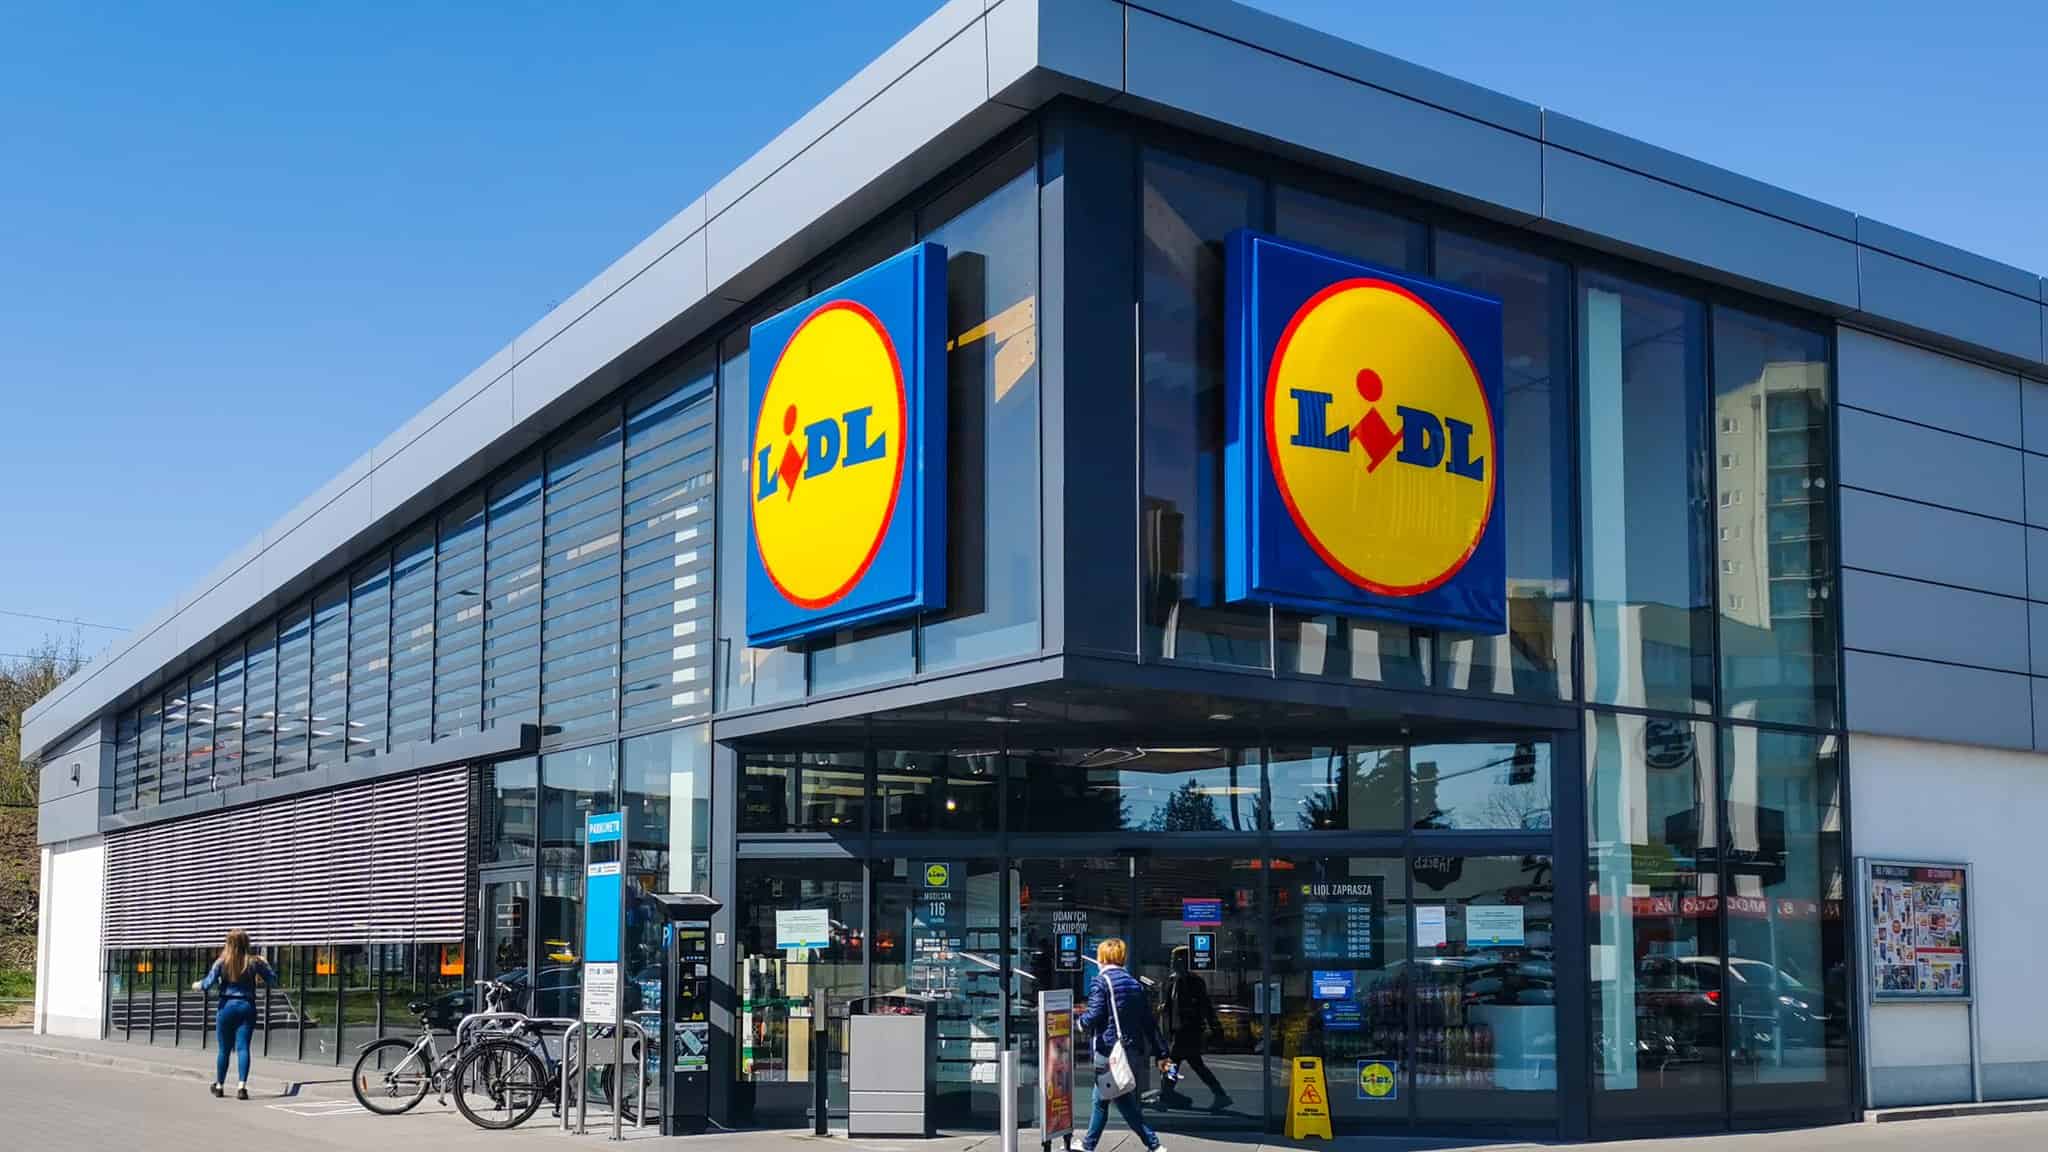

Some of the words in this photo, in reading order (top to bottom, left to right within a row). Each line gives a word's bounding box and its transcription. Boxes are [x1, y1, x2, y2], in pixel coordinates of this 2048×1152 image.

[1313, 884, 1331, 896] LIDL
[1332, 884, 1373, 896] ZAPRASZA
[930, 902, 945, 917] 116
[1053, 911, 1087, 921] UDANYCH
[1064, 936, 1073, 949] P
[1198, 937, 1206, 949] P
